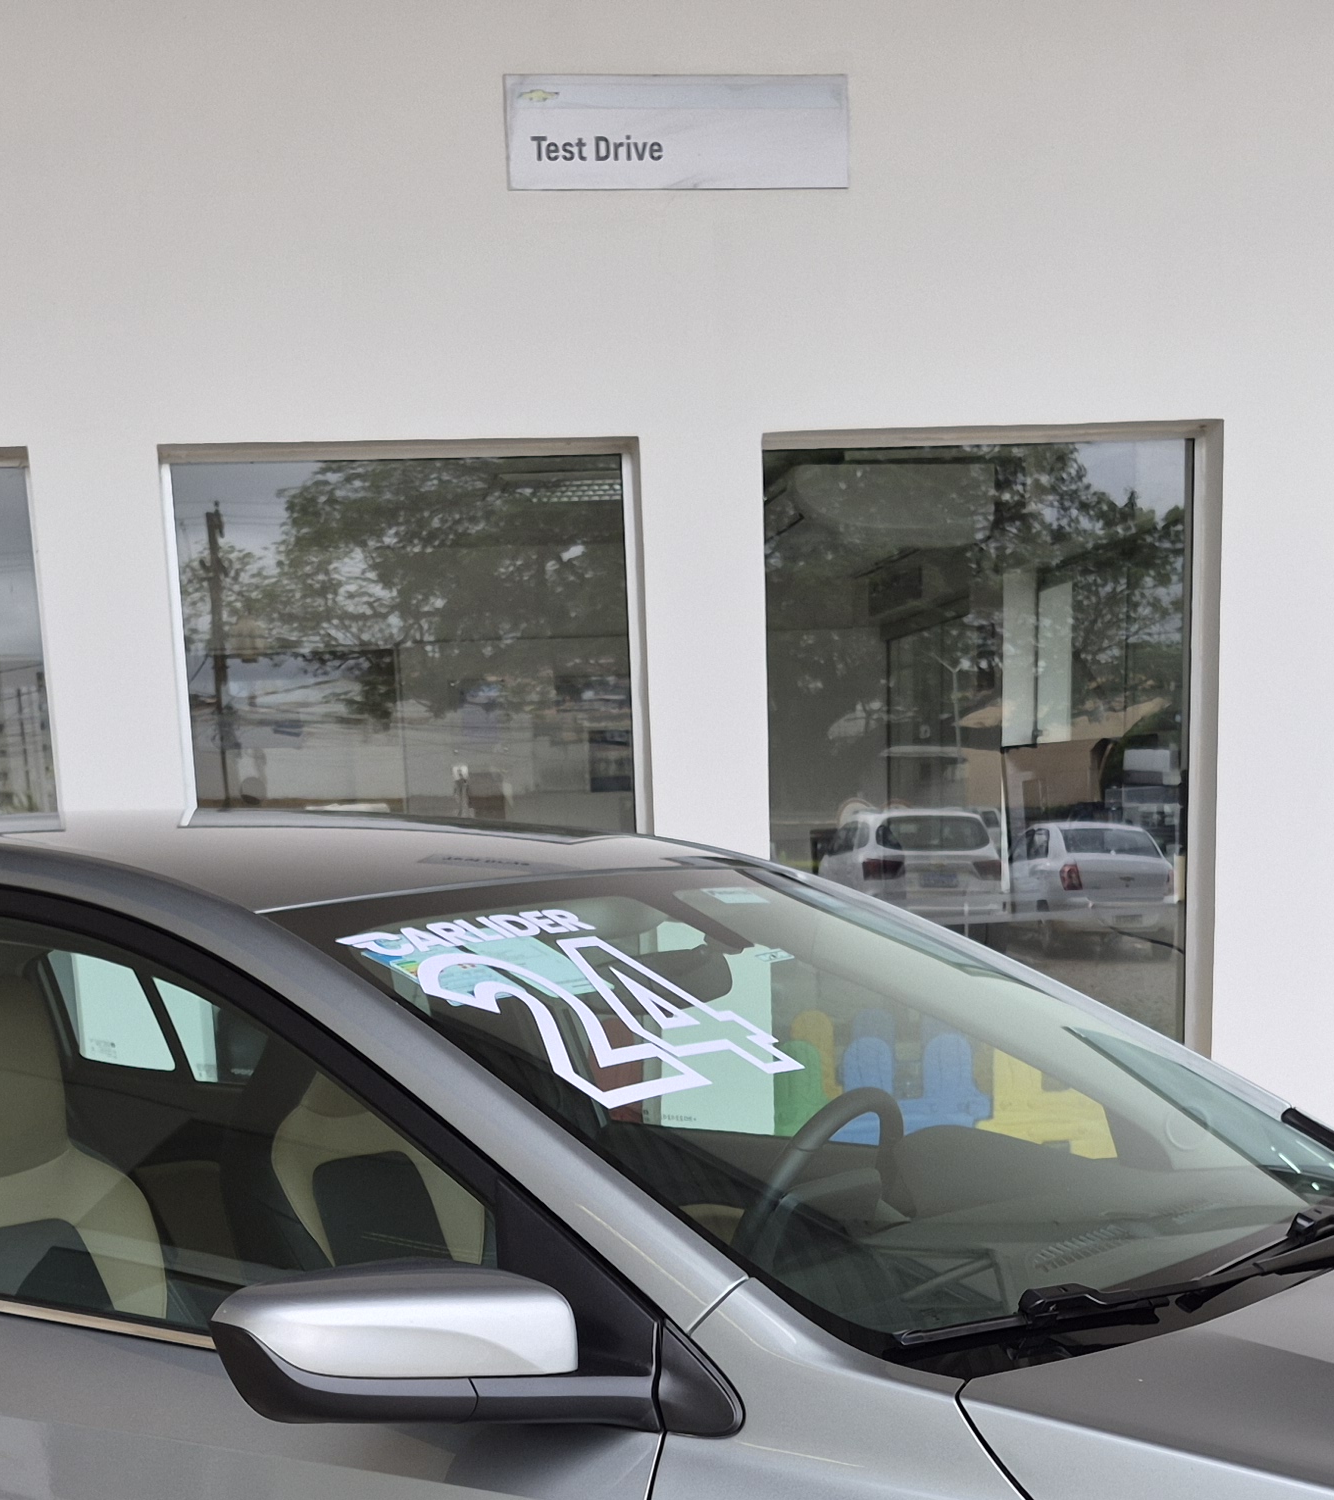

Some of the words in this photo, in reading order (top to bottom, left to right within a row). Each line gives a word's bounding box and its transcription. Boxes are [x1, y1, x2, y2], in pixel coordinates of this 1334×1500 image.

[530, 135, 587, 162] Test
[594, 135, 664, 162] Drive
[334, 908, 597, 956] CARLIDER
[417, 935, 805, 1109] 24
